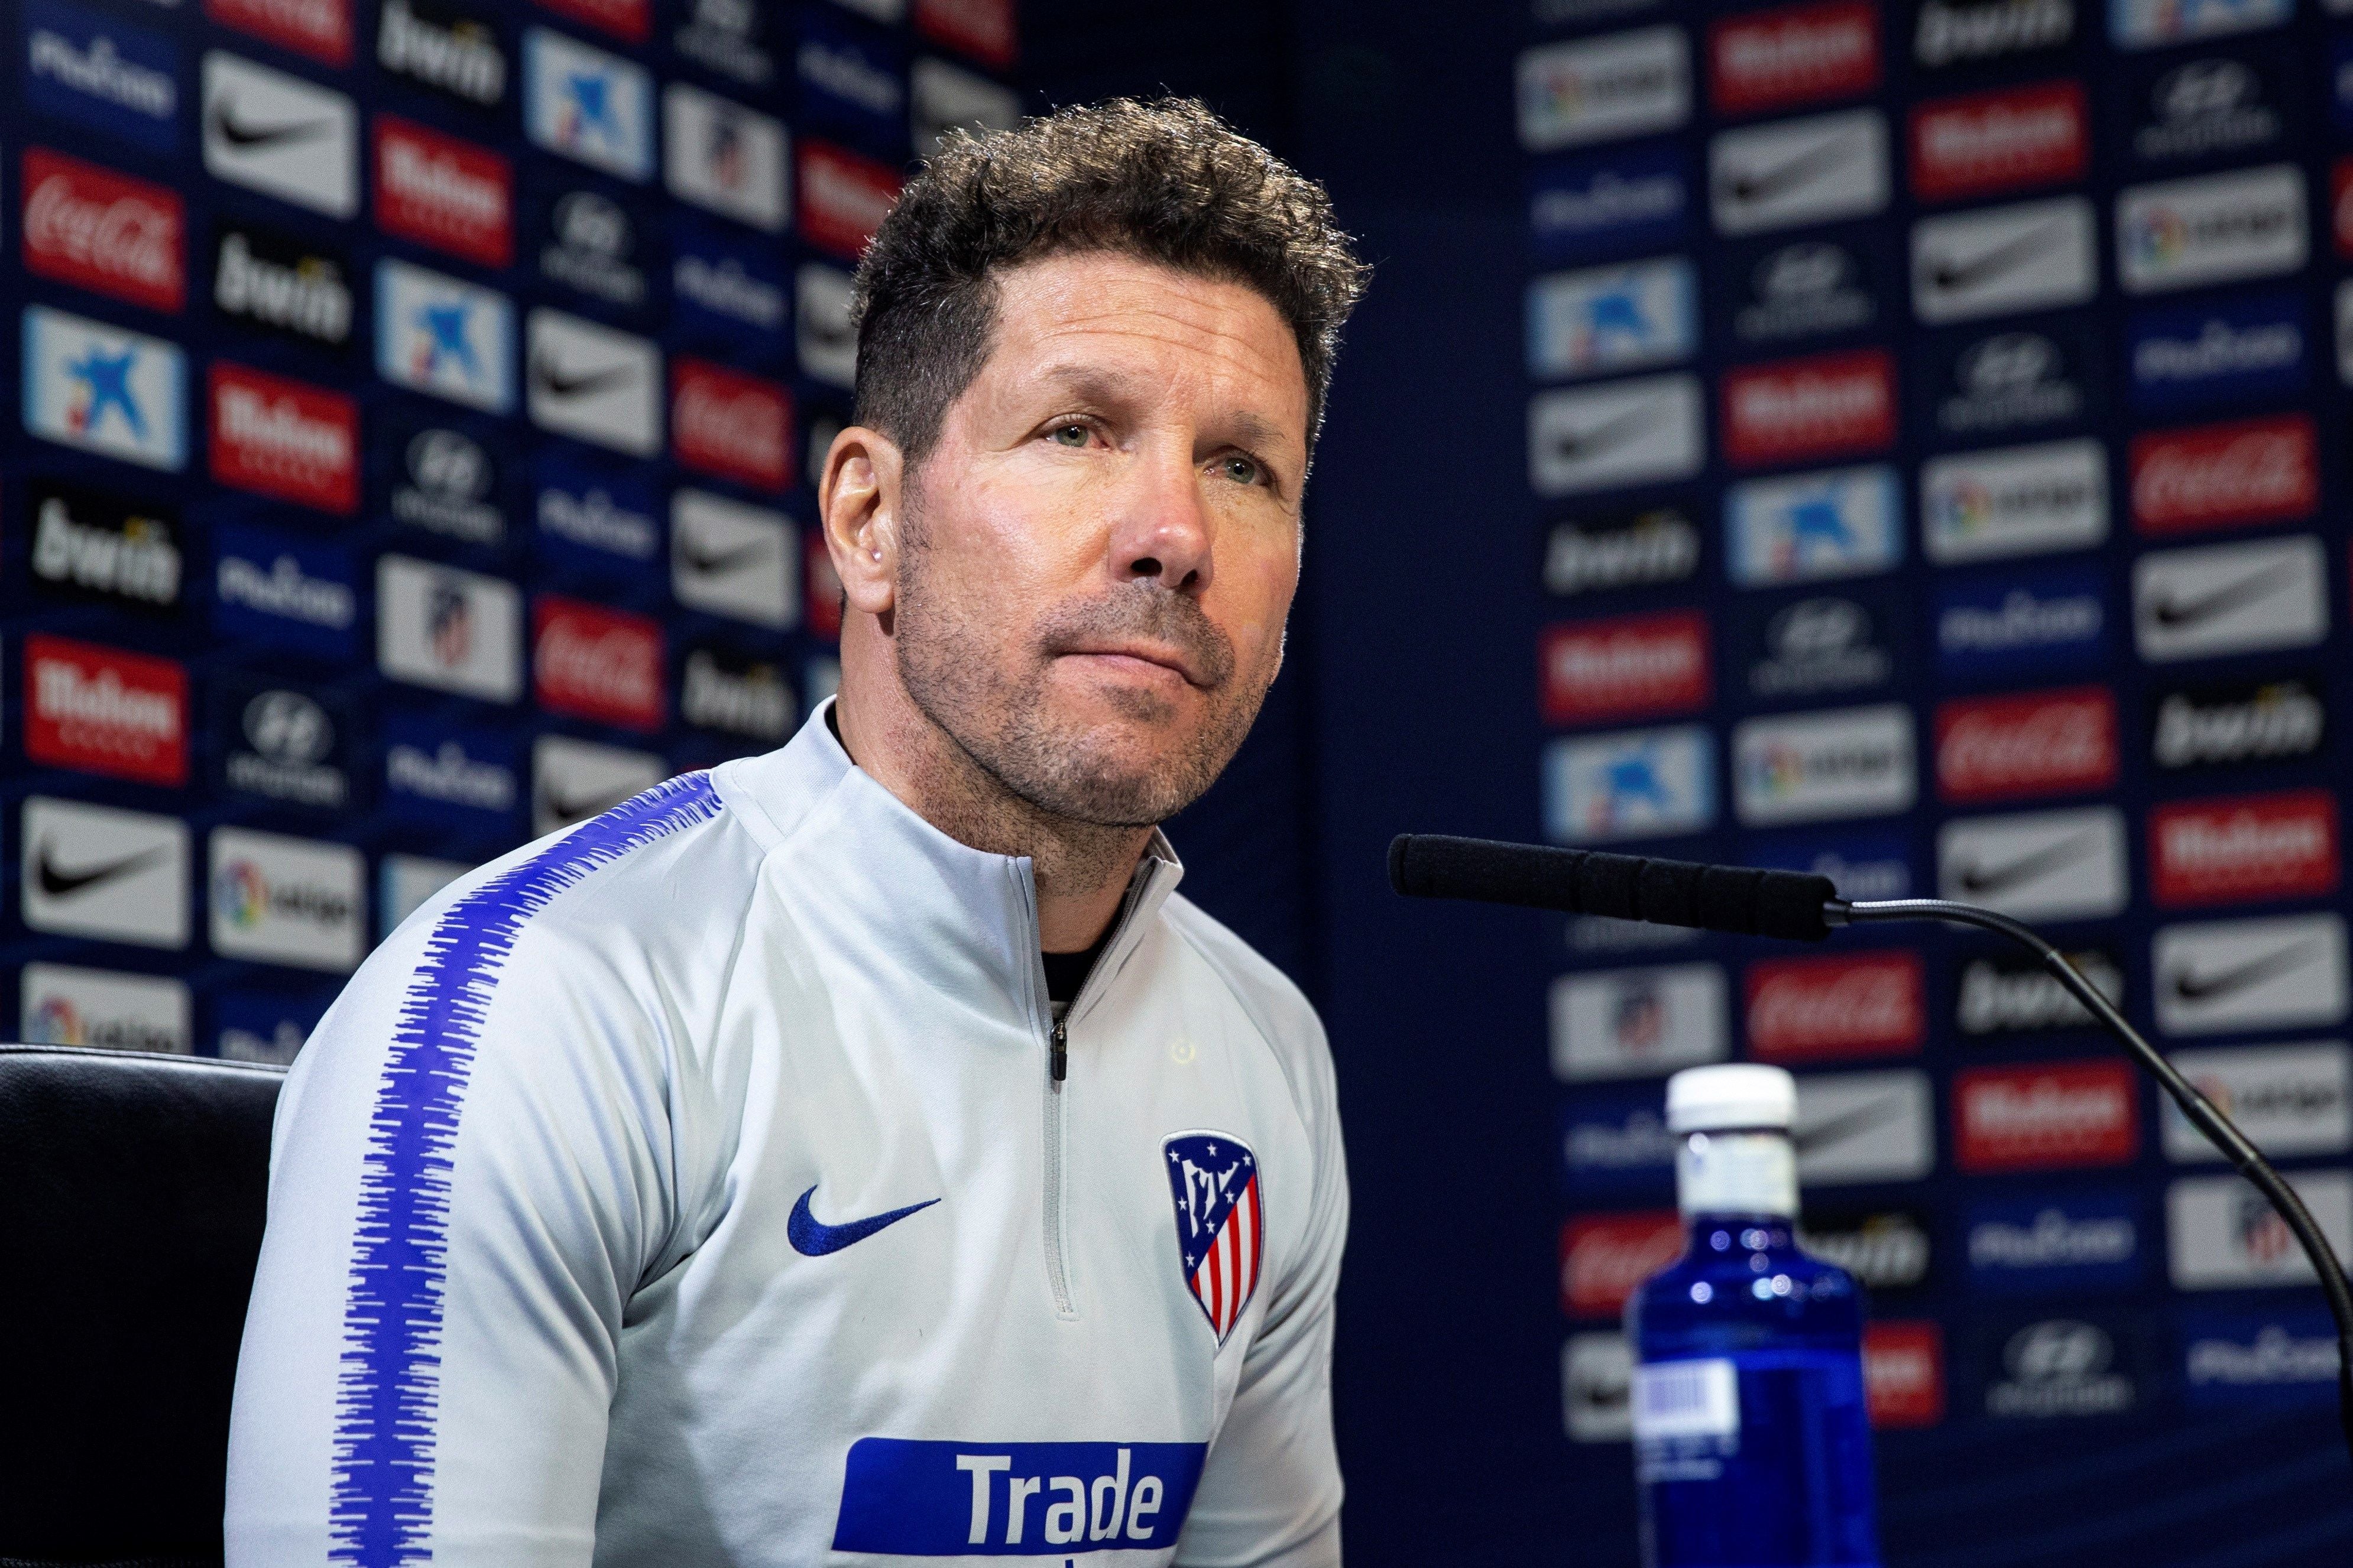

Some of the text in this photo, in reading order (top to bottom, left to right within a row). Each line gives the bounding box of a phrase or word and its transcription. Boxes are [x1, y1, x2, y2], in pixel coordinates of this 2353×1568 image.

[215, 232, 353, 345] bwin
[33, 498, 181, 604] bwin
[2154, 681, 2322, 767] bwin
[956, 1448, 1163, 1544] Trade
